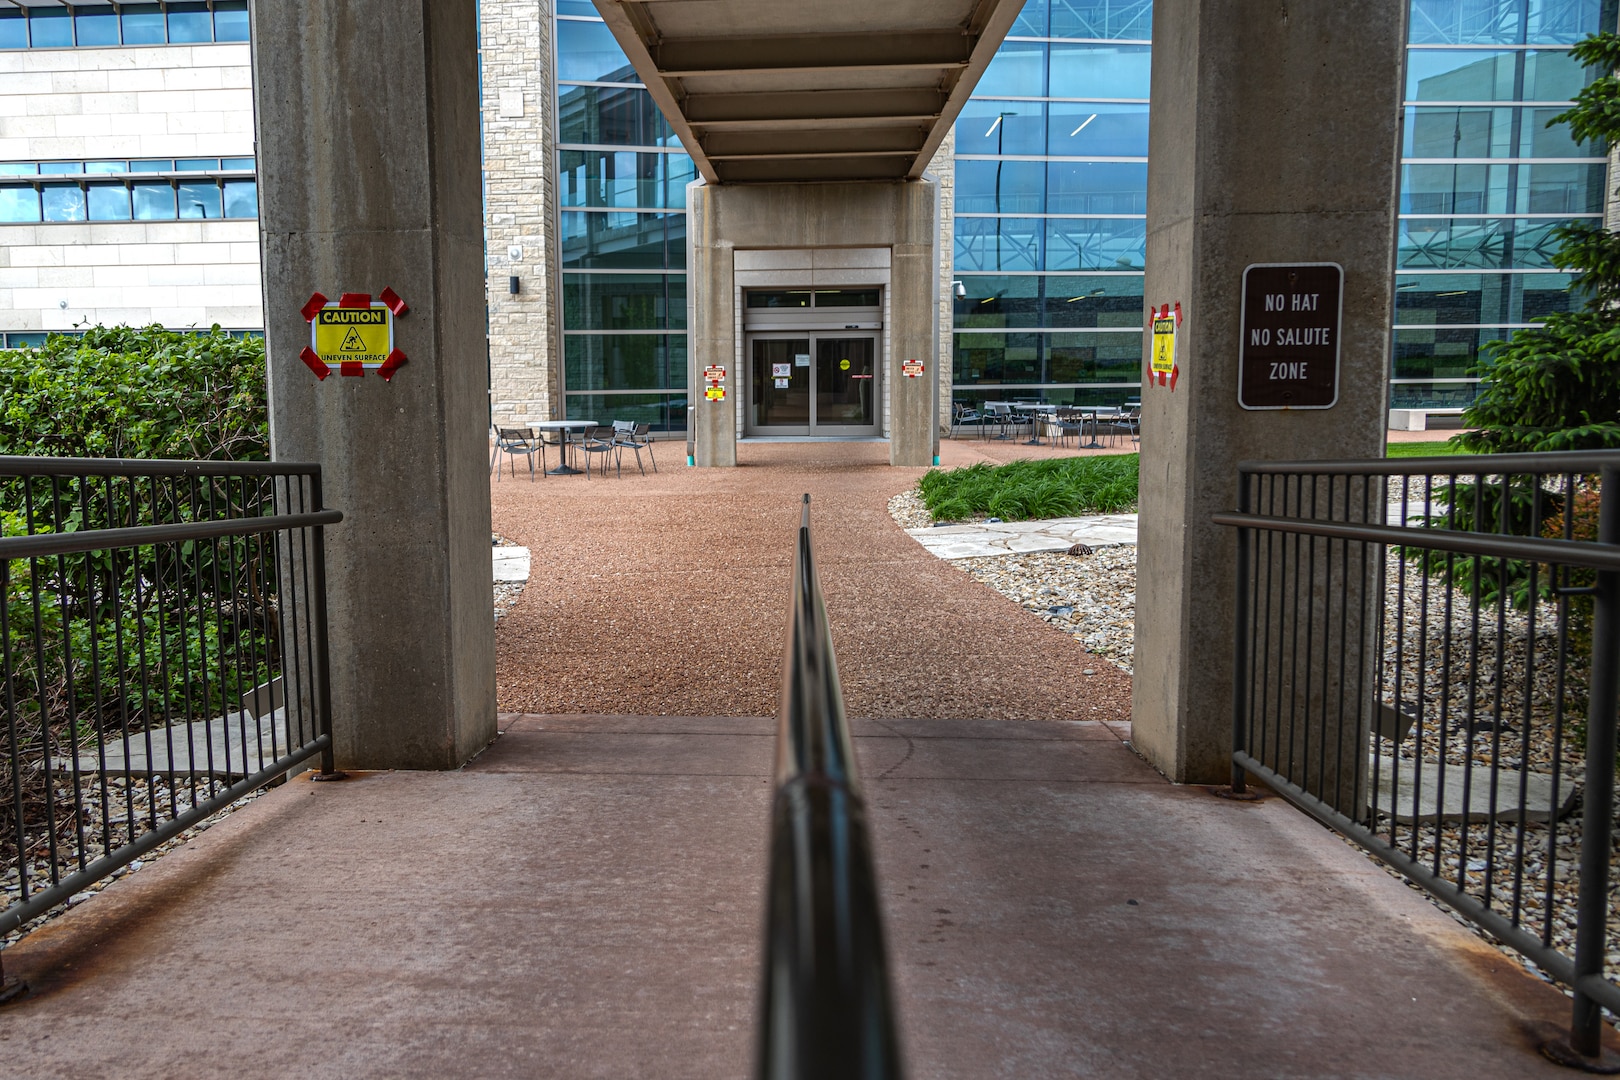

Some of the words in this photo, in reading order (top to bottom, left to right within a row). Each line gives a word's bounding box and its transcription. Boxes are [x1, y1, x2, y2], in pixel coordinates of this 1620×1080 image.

[1265, 294, 1285, 311] NO
[1291, 294, 1319, 311] HAT
[323, 311, 381, 323] CAUTION
[1251, 328, 1270, 346] NO
[1276, 328, 1330, 345] SALUTE
[1269, 362, 1308, 380] ZONE
